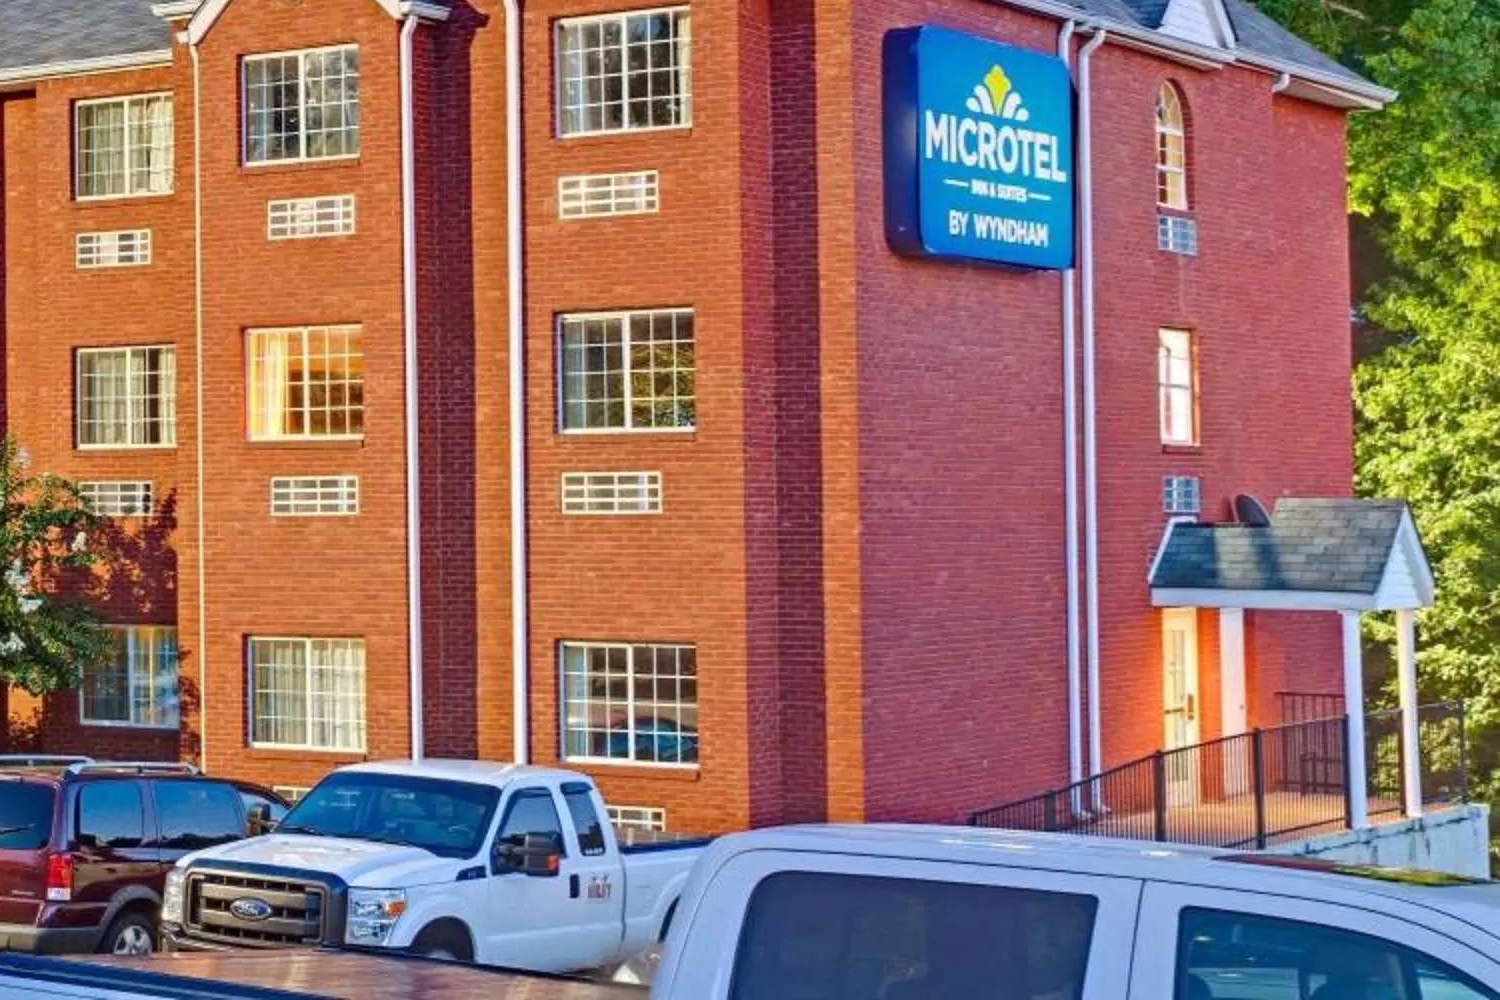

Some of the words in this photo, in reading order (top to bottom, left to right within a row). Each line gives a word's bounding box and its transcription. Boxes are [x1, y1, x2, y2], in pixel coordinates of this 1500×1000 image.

[925, 110, 1067, 183] MICROTEL
[949, 209, 968, 236] BY
[974, 213, 1048, 247] WYNDHAM
